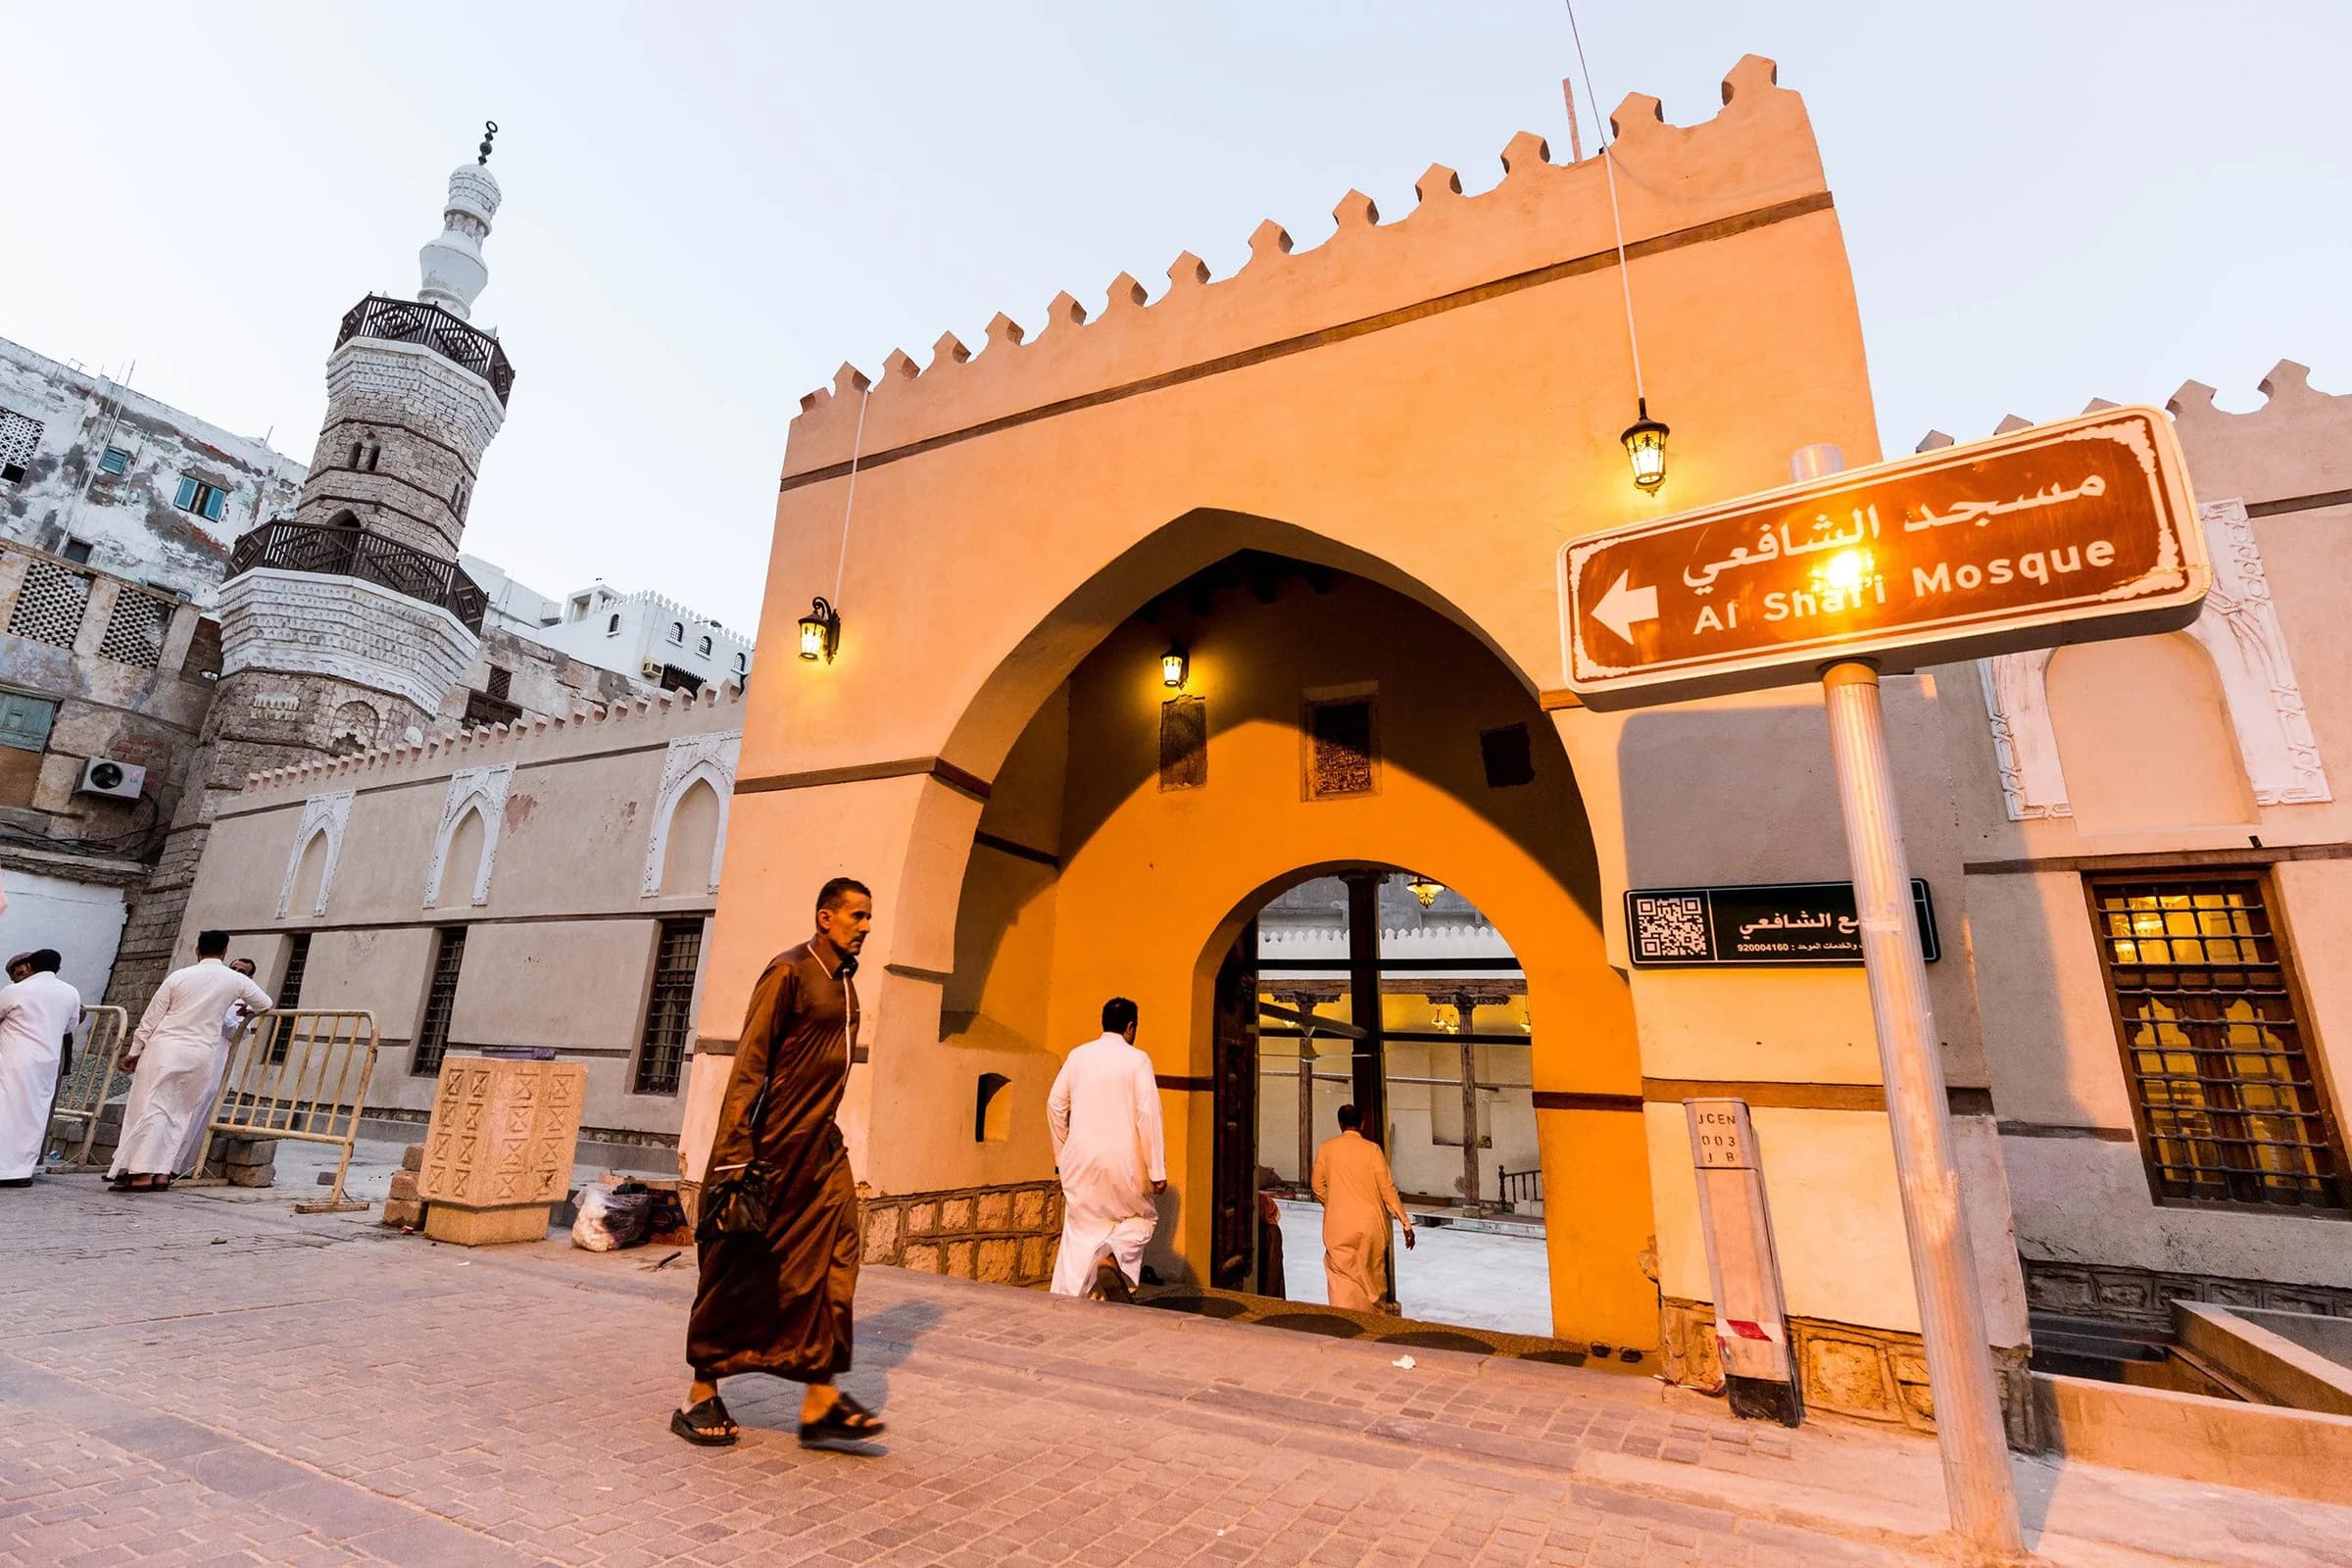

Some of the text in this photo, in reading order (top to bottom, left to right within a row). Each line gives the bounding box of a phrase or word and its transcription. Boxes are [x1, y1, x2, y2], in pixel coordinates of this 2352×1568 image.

[1684, 474, 2106, 596] مسجد الشافعي
[1693, 601, 1737, 635] Al
[1912, 540, 2116, 598] Mosque
[1740, 910, 1832, 940] الشافعي
[1737, 943, 1789, 952] 920004160
[1698, 1113, 1736, 1125] JCEN
[1701, 1135, 1736, 1147] 003
